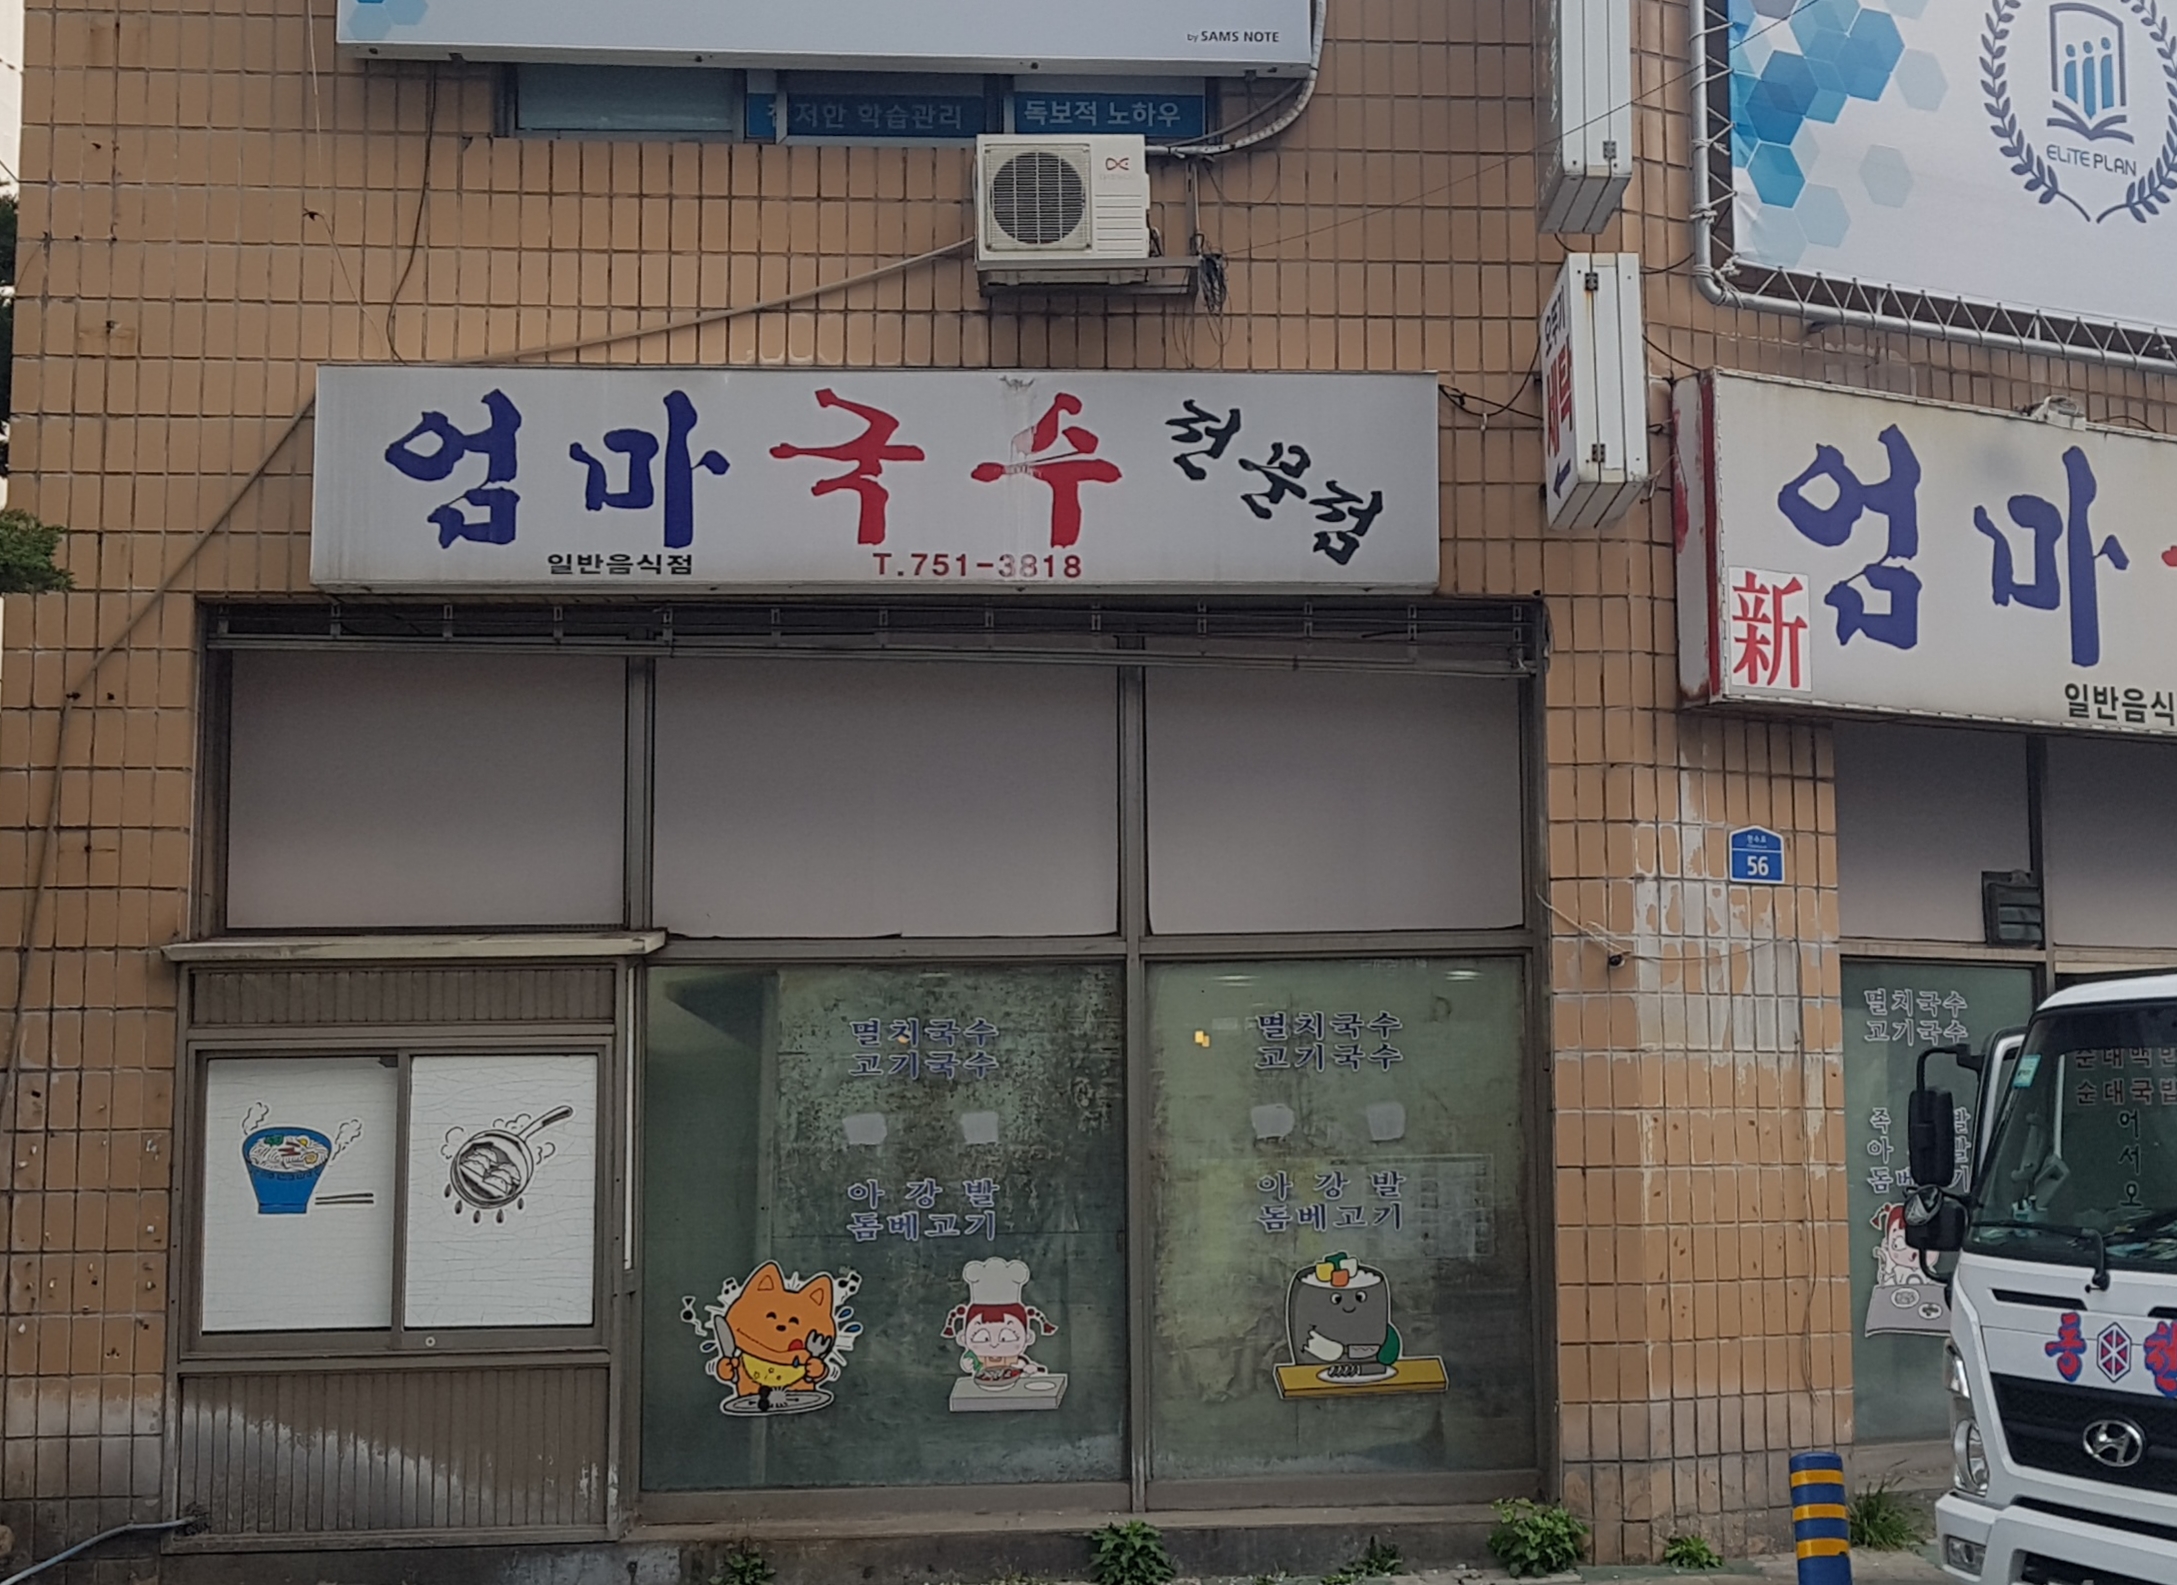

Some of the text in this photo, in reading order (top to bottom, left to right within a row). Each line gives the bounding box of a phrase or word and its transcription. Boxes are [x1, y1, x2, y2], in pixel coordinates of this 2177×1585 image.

[1200, 30, 1239, 42] SAMS
[1243, 30, 1280, 42] NOTE
[858, 101, 963, 130] 학습관리
[1023, 100, 1181, 127] 독보적 노하우
[1546, 333, 1573, 458] 세탁
[1165, 399, 1384, 566] 전문점
[1777, 423, 2130, 668] 엄마
[546, 552, 694, 576] 일반음식점
[1732, 570, 1808, 689] 新
[2064, 682, 2176, 727] 일반음식
[1747, 855, 1770, 876] 56
[1863, 987, 1969, 1019] 멸치국수
[849, 1017, 1000, 1048] 멸치국수
[1256, 1010, 1404, 1040] 멸치국수
[1863, 1018, 1970, 1047] 고기국수
[848, 1050, 1000, 1080] 고기국수
[1254, 1043, 1404, 1073] 고기국수
[846, 1210, 998, 1242] 돔베고기
[1257, 1202, 1404, 1233] 돔베고기
